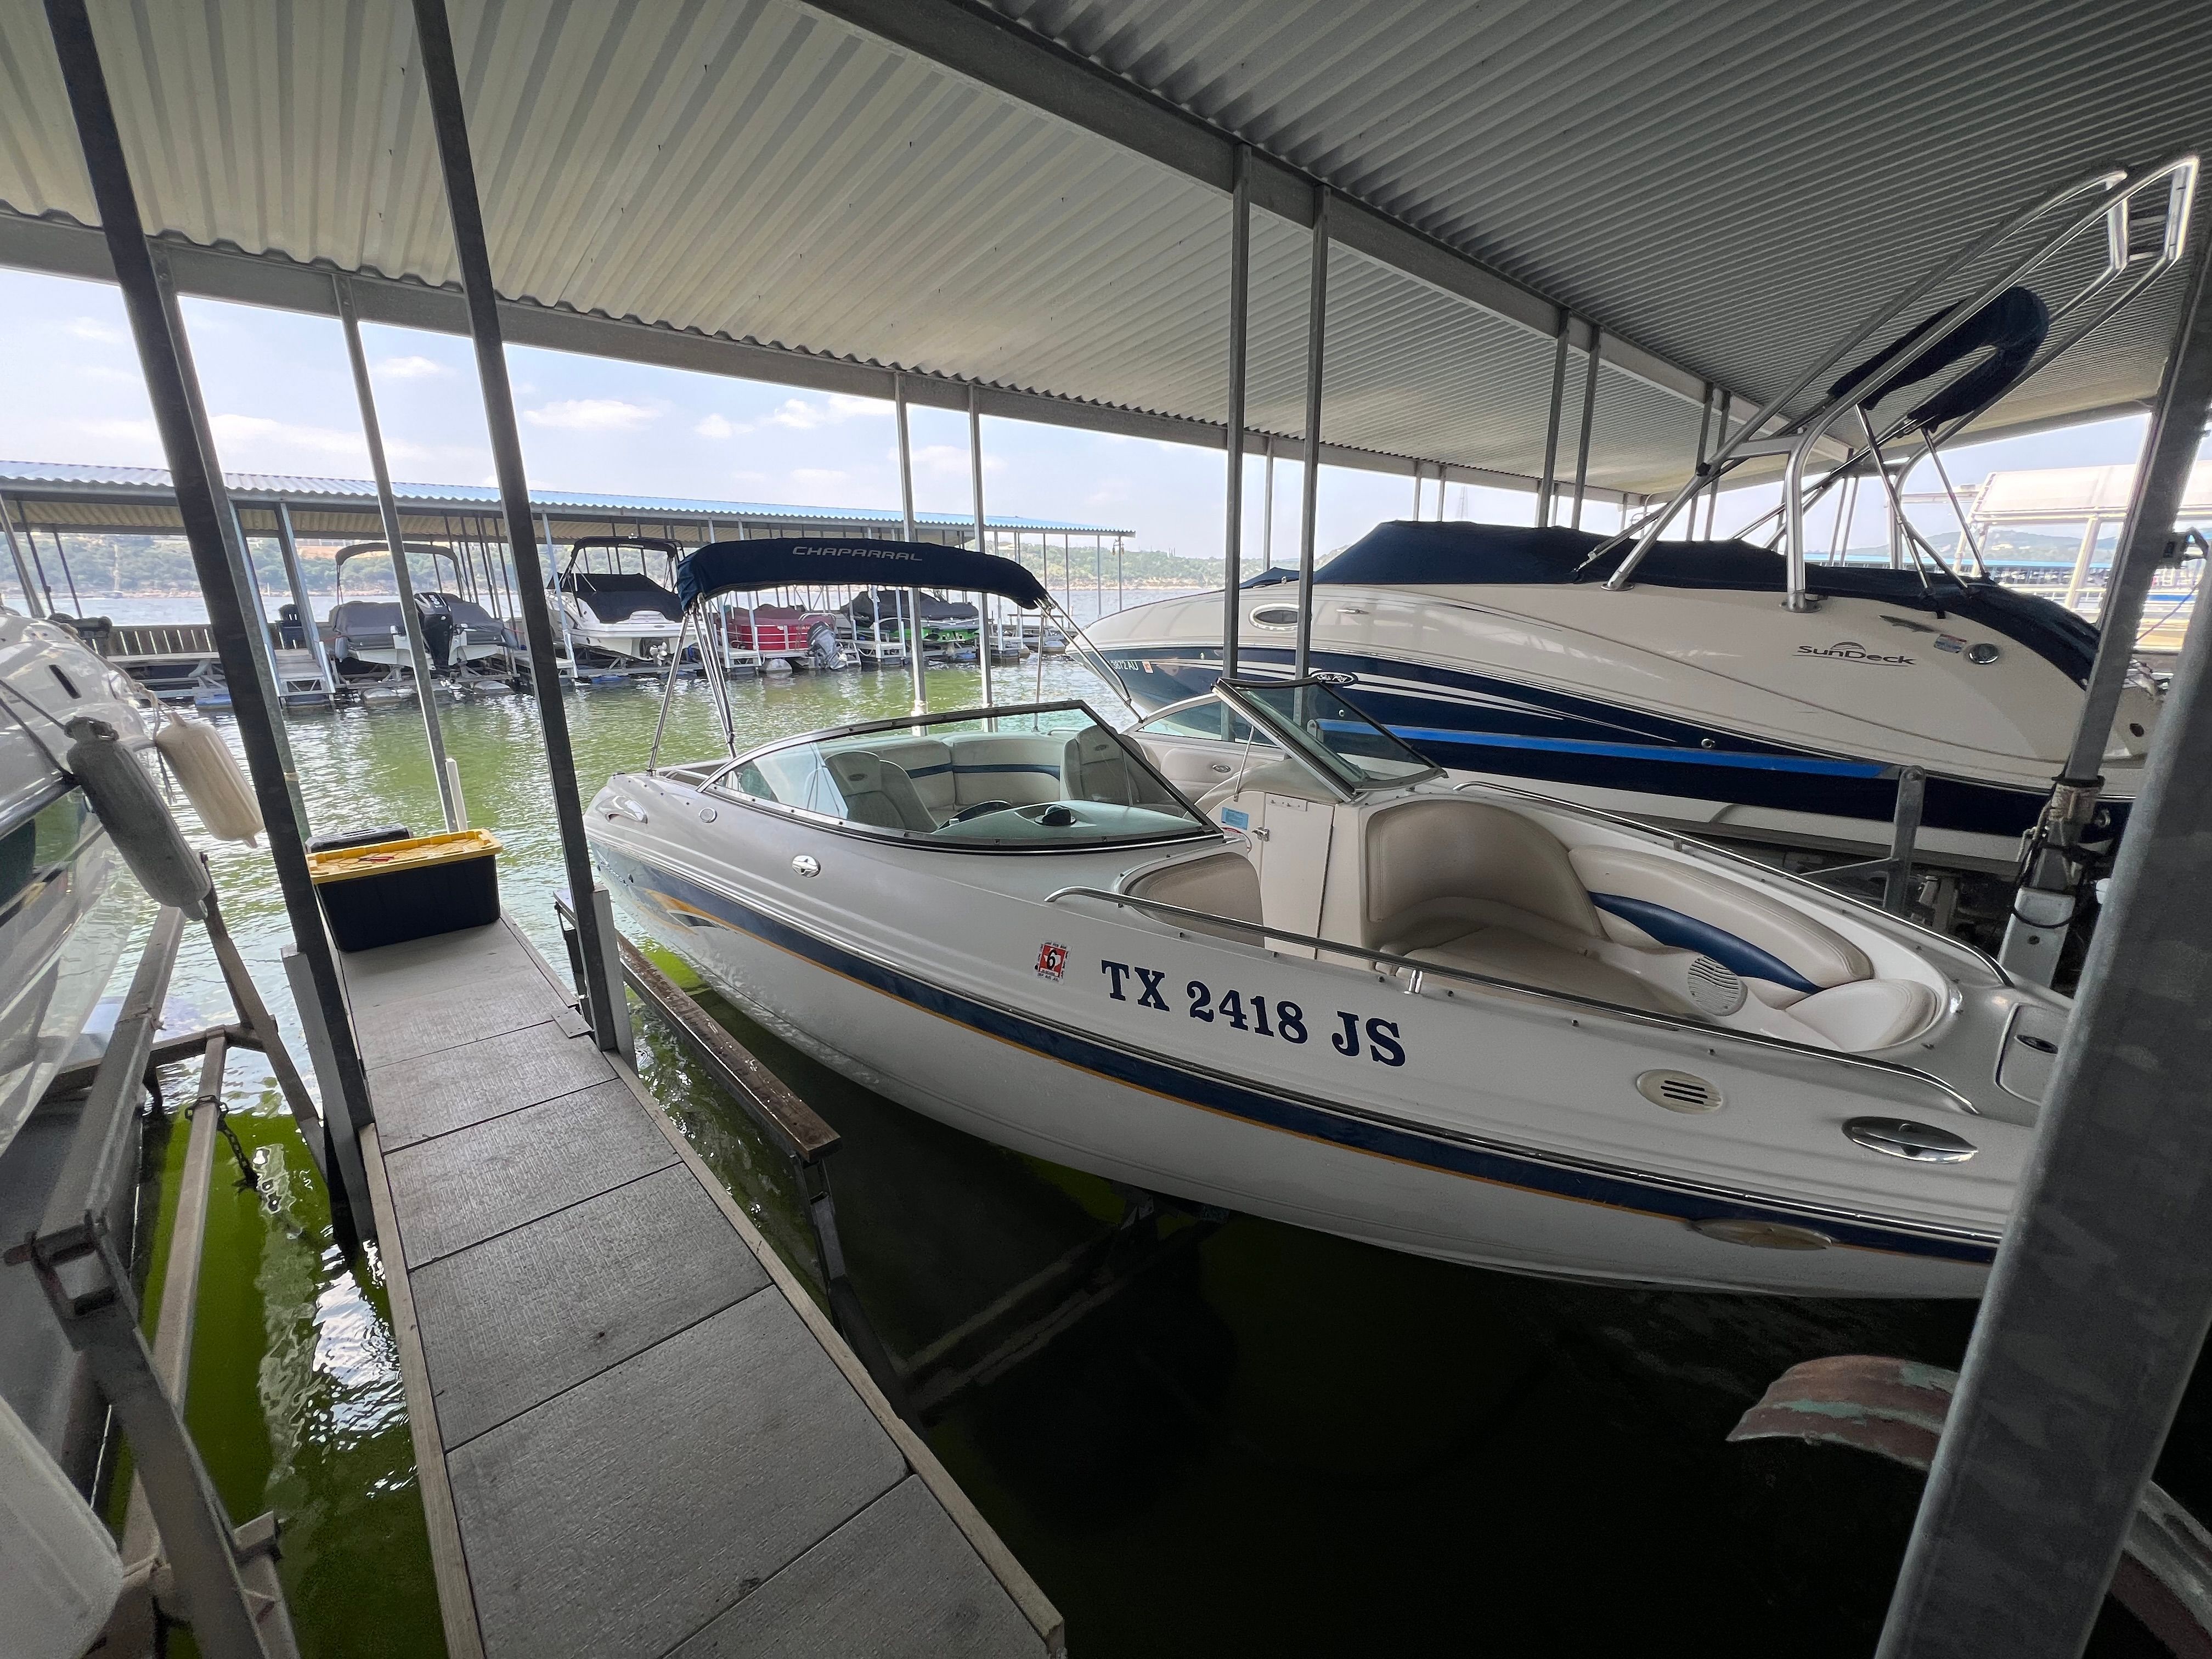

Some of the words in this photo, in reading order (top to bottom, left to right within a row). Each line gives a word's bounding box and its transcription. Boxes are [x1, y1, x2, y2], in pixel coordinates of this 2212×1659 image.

[792, 546, 923, 561] CHAPARRAL
[1797, 646, 1916, 665] SunDeck
[1047, 949, 1057, 970] 6
[1101, 959, 1170, 1012] TX
[1186, 980, 1308, 1045] 2418
[1331, 1011, 1406, 1066] JS
